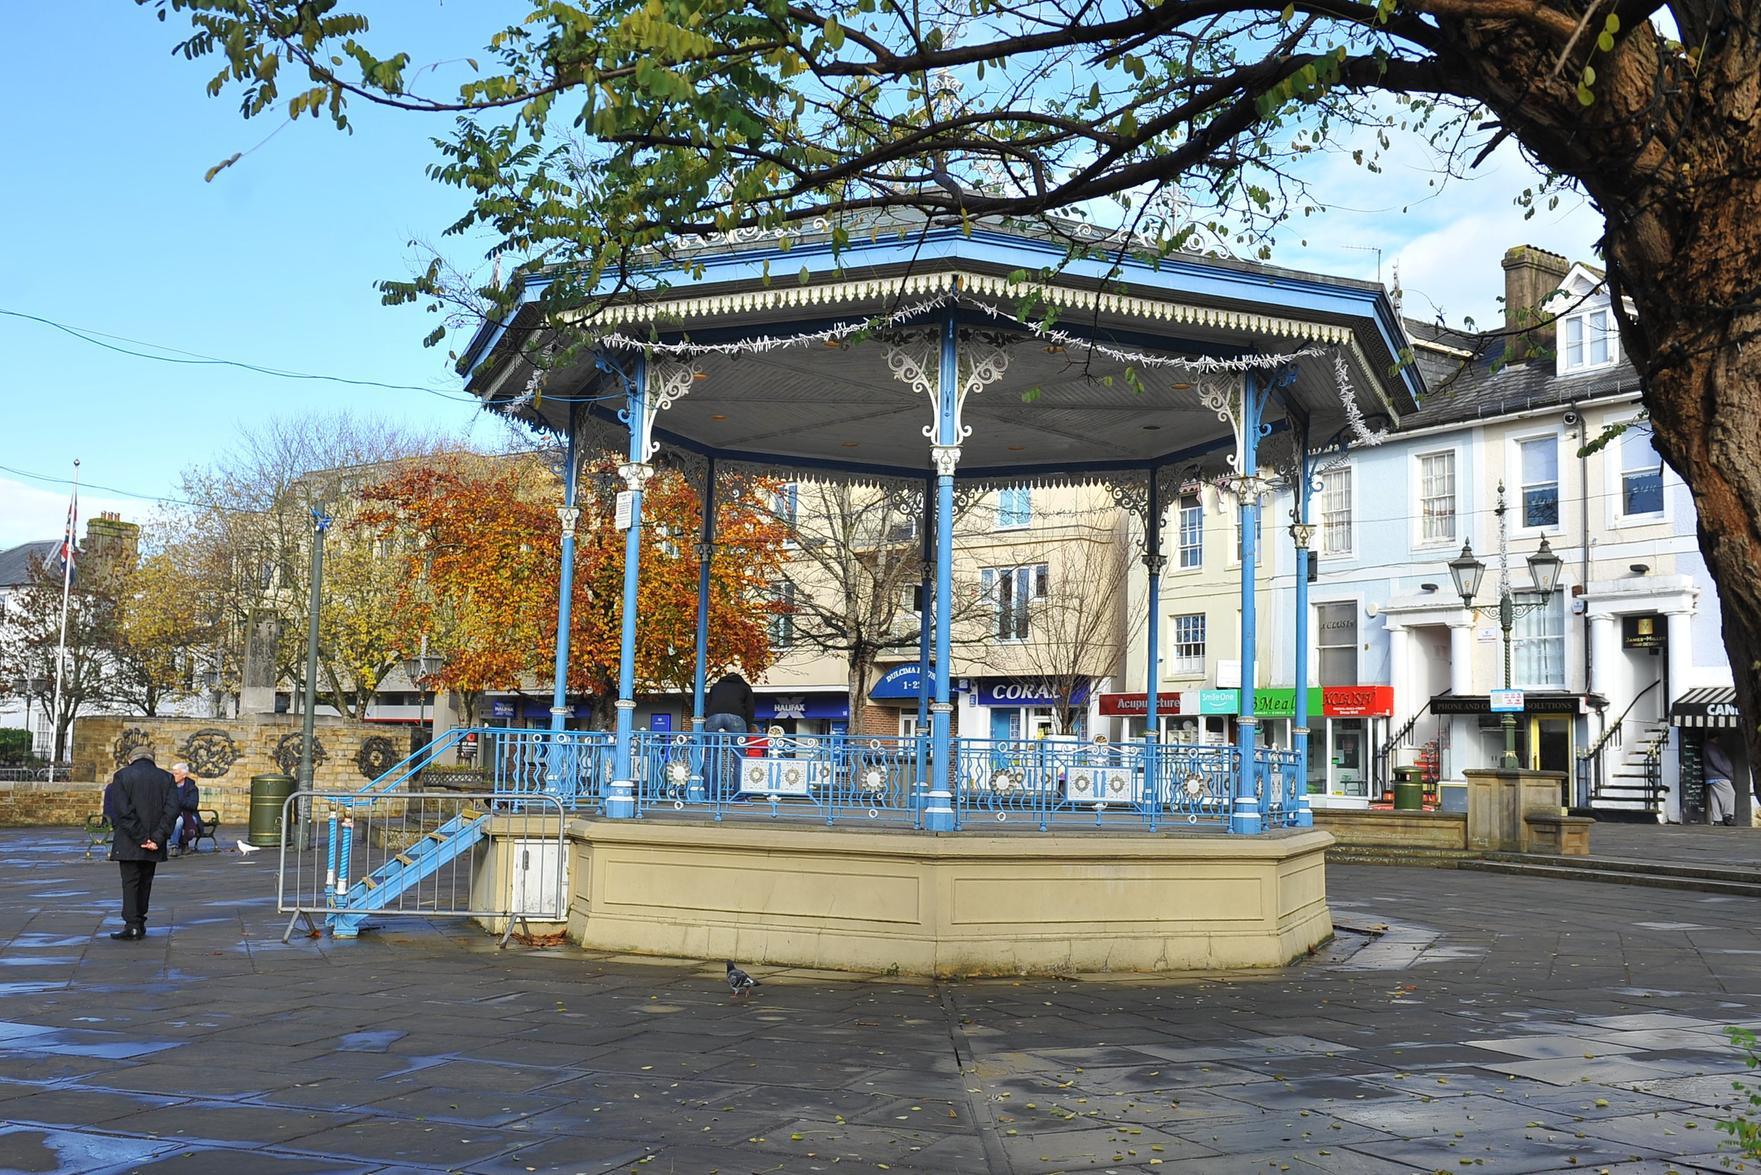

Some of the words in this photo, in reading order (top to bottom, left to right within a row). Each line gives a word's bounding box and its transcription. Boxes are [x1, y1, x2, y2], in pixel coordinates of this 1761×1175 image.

[886, 666, 916, 683] DULCIMA
[992, 684, 1061, 699] CORAL
[774, 703, 806, 712] HALIFAX
[1117, 697, 1181, 711] Acupucture
[1525, 701, 1573, 710] SOLUTIONS
